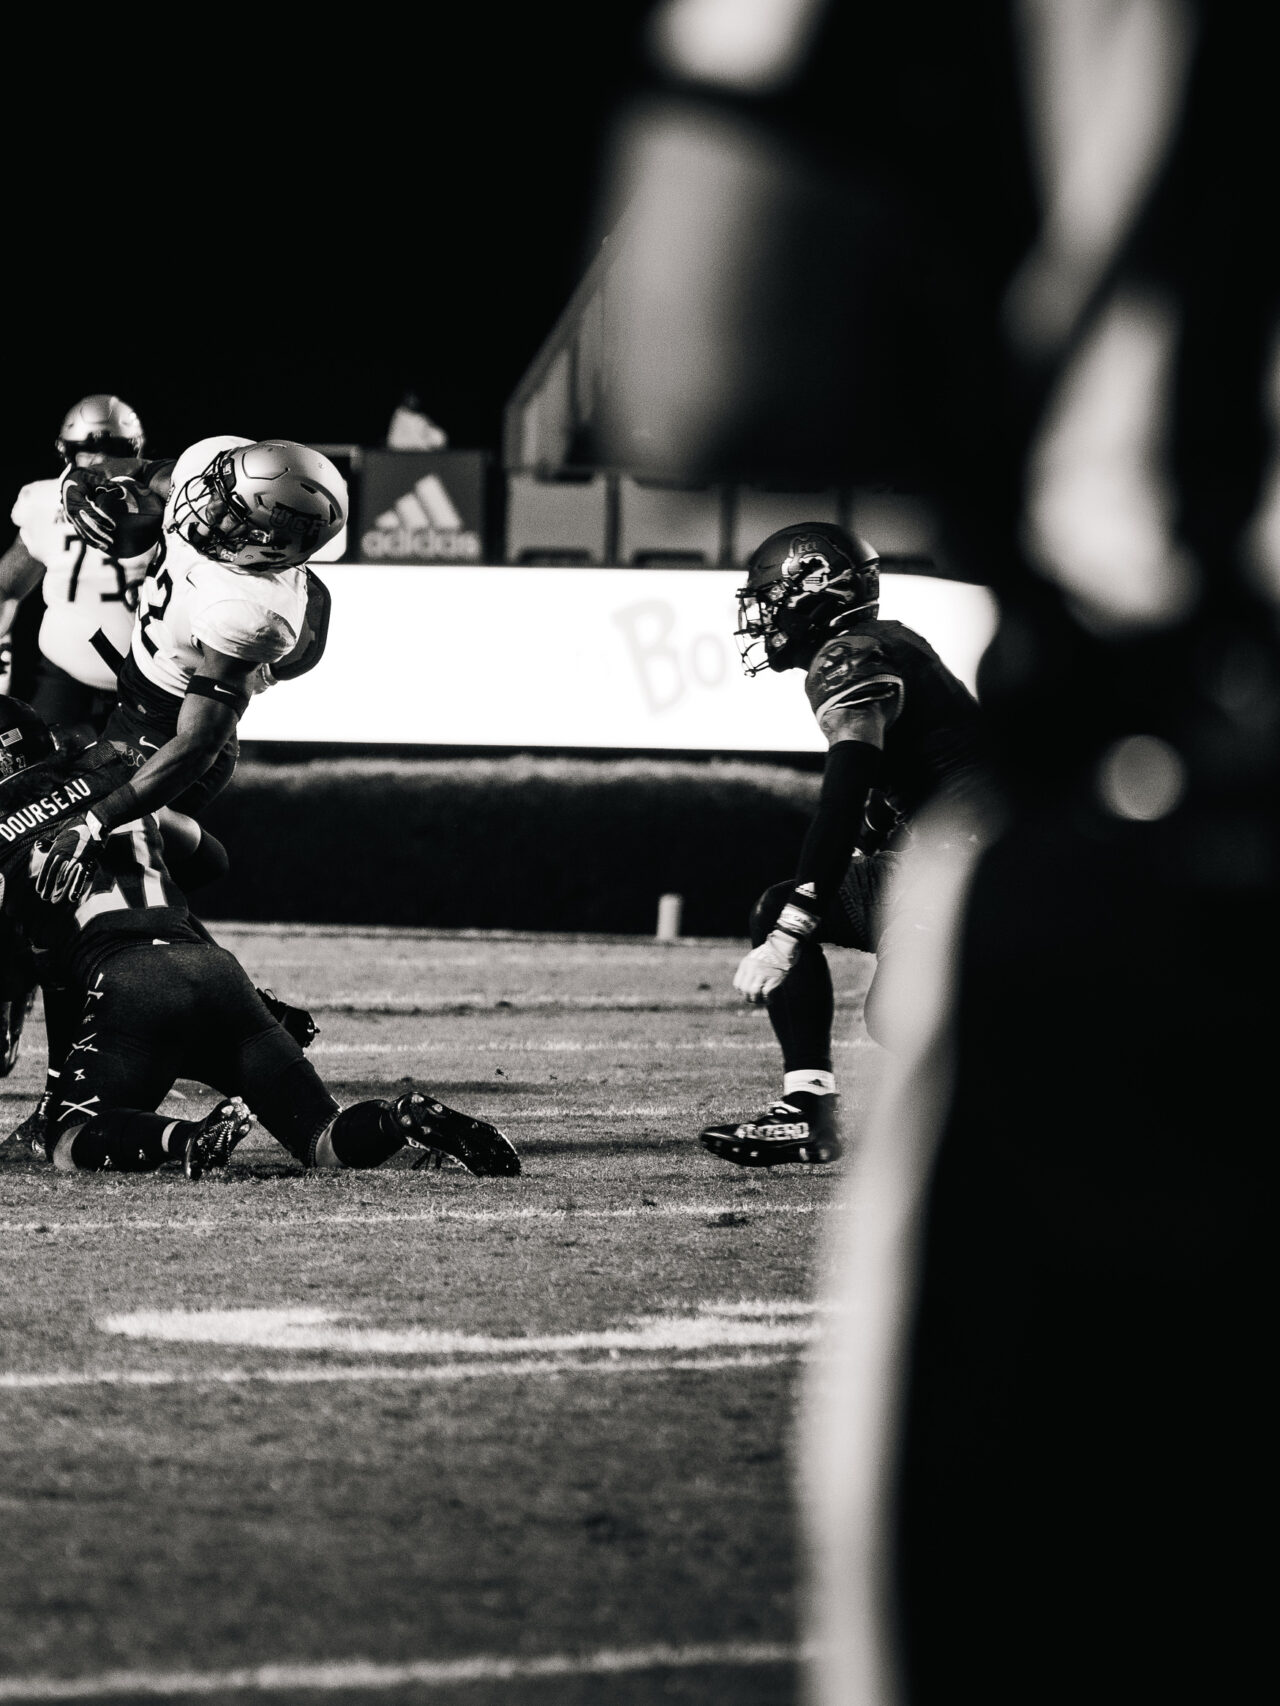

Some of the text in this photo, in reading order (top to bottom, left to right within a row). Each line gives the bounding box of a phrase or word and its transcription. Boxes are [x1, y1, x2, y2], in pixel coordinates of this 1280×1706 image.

[269, 504, 327, 537] UCF
[361, 530, 482, 559] adidas
[65, 534, 126, 602] 73
